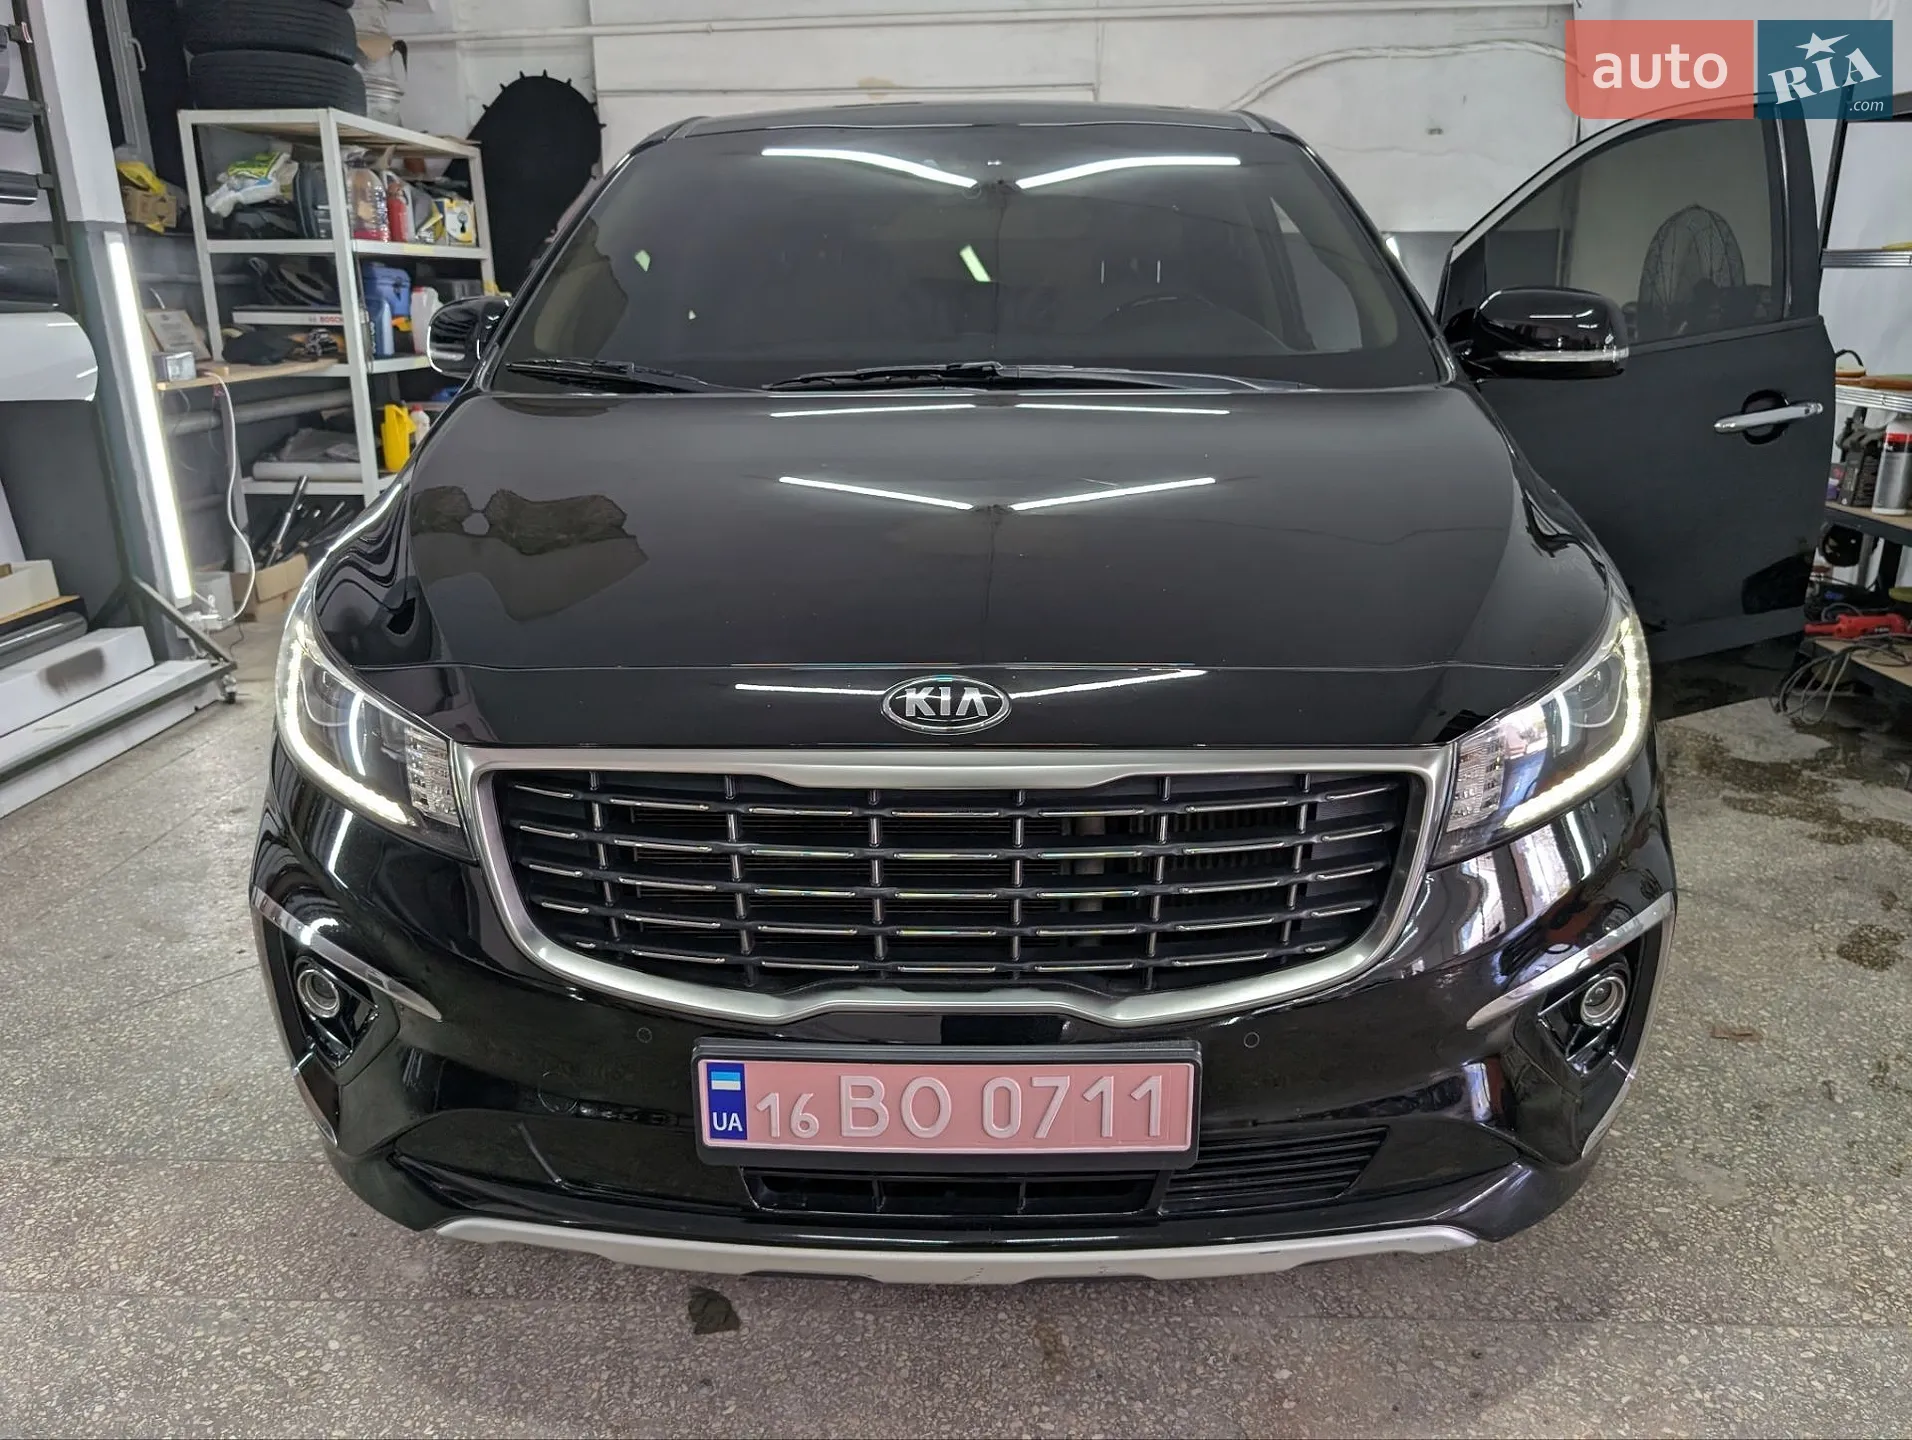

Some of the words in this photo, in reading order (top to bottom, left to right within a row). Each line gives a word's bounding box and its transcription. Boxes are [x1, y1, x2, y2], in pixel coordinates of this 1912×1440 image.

[905, 686, 988, 716] KIA
[712, 1112, 743, 1132] UA
[756, 1092, 820, 1139] 16
[839, 1075, 952, 1138] BO
[982, 1076, 1164, 1139] 0711
